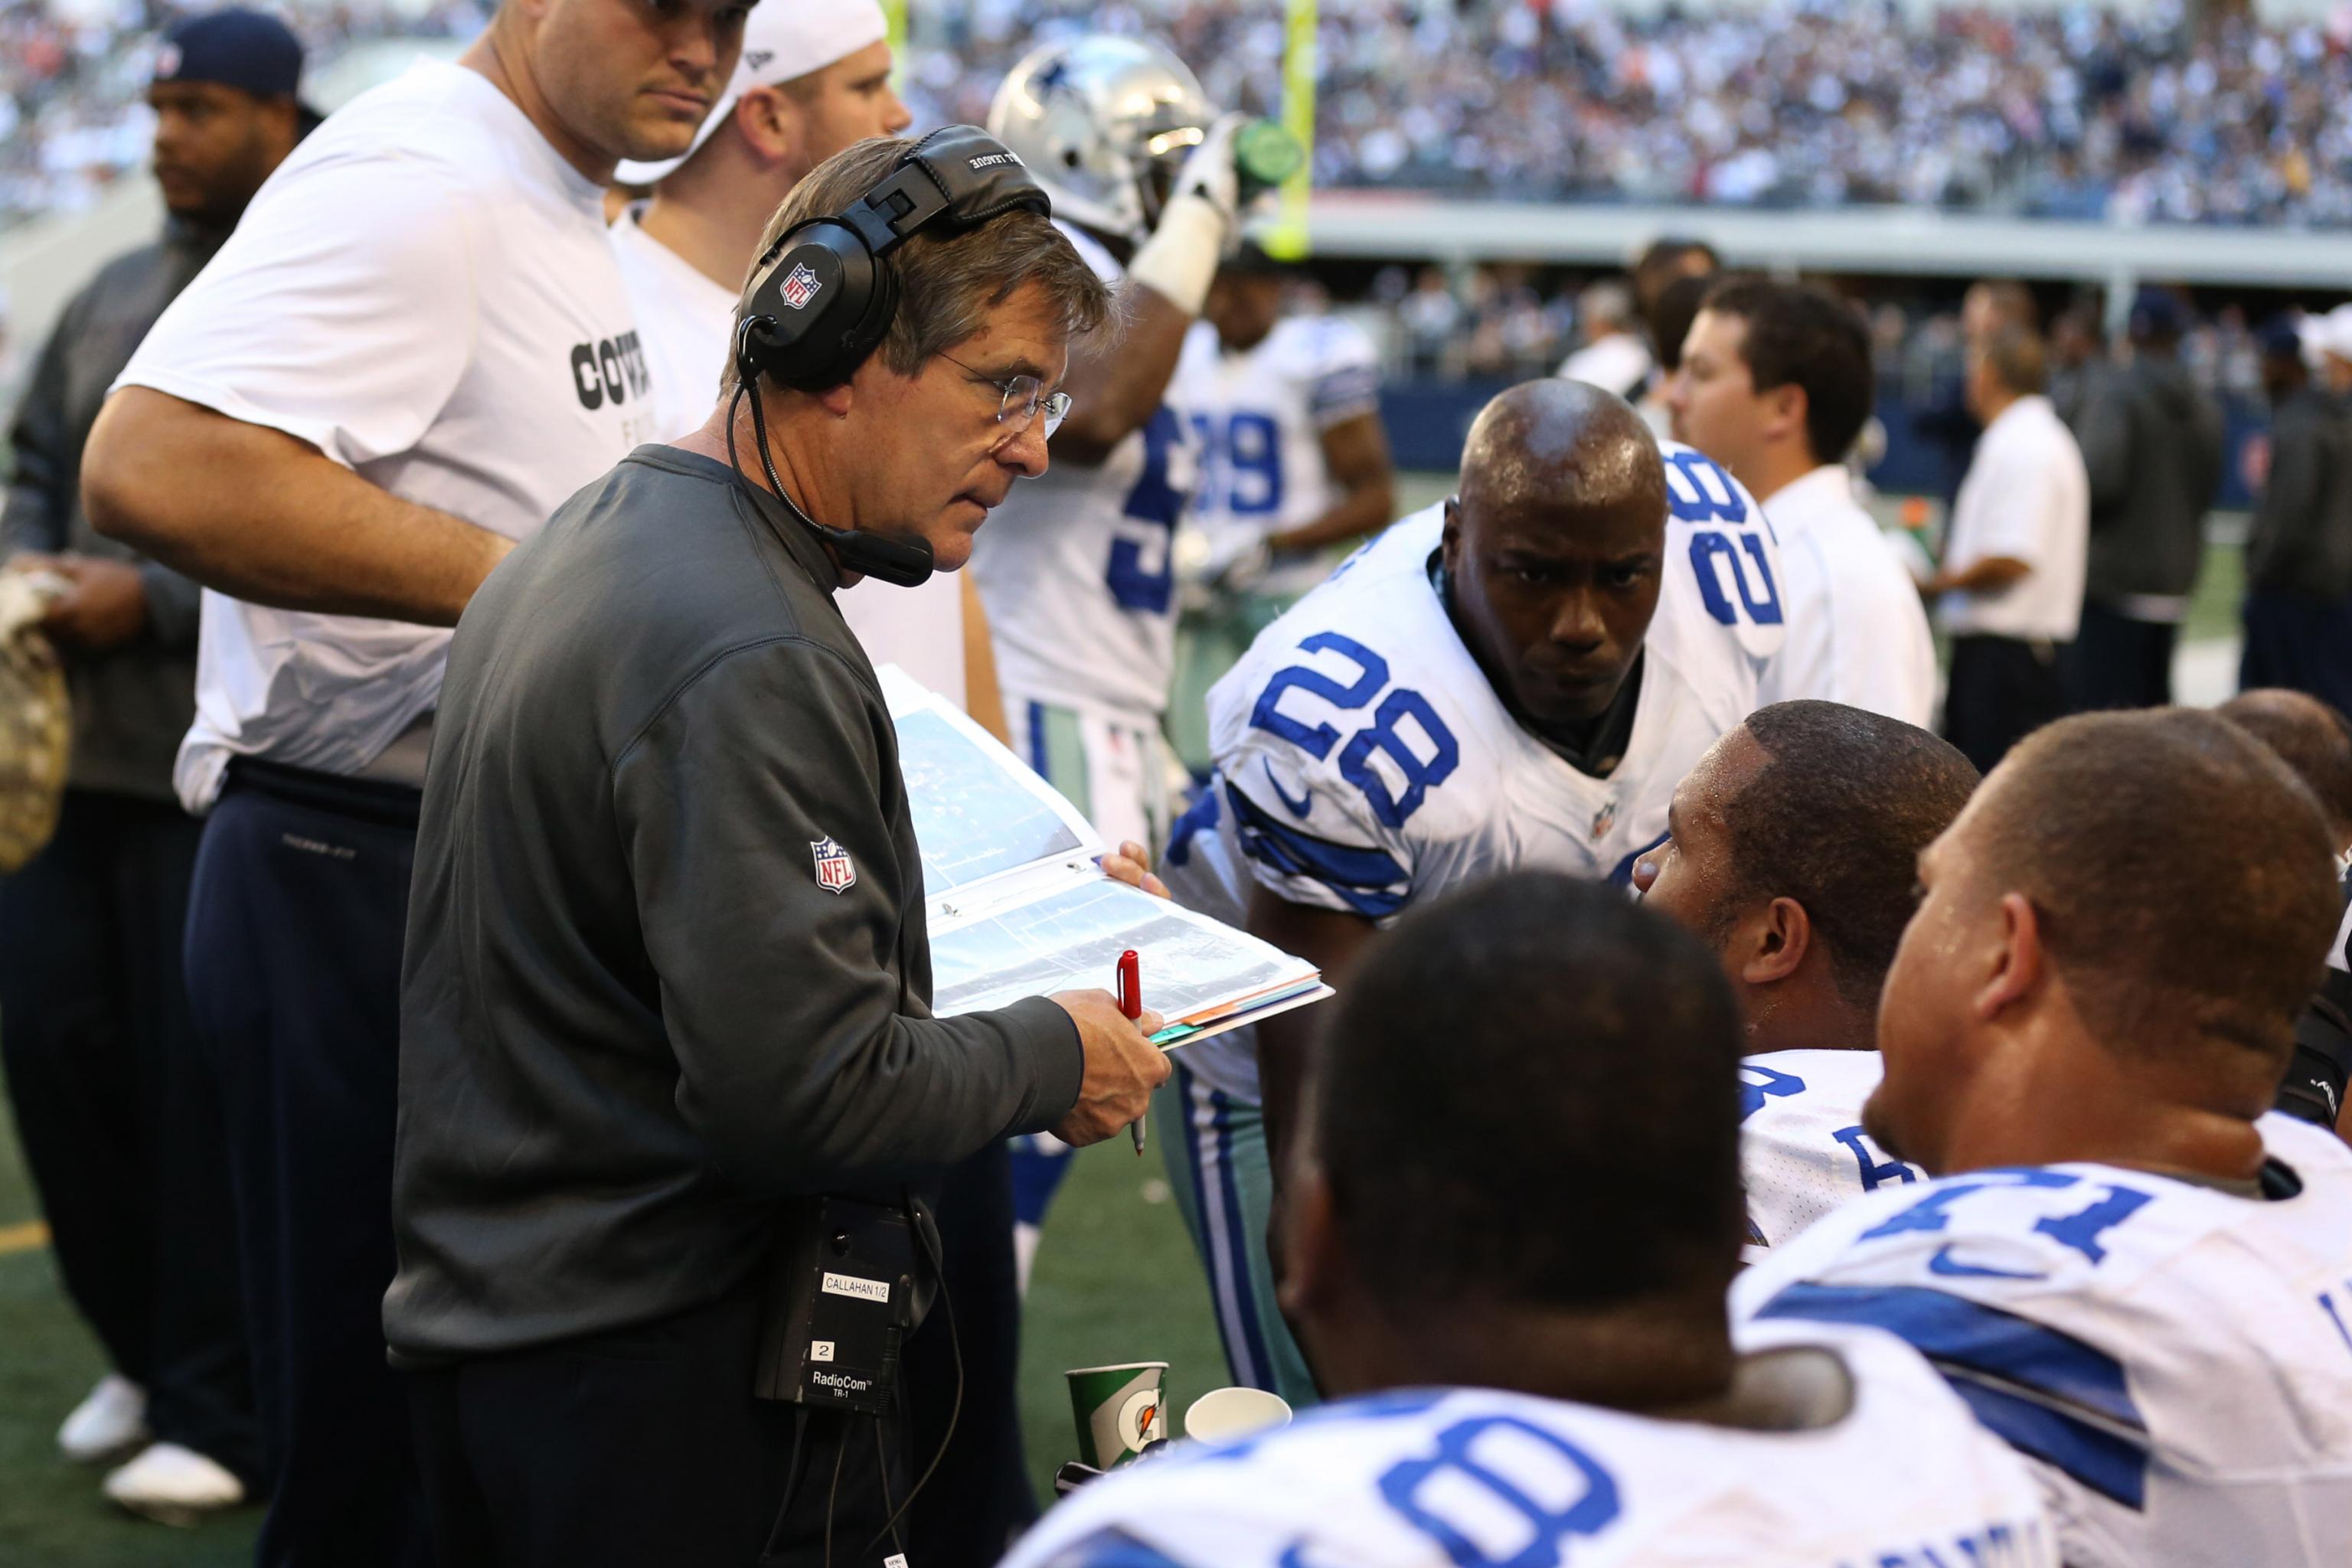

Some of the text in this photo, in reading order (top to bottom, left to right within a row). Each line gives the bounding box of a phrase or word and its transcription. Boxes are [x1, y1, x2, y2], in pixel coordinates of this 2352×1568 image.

[969, 154, 1005, 168] LEAGUE
[784, 277, 808, 305] NFL
[1663, 452, 1785, 625] 28
[1250, 631, 1459, 829] 28
[821, 859, 852, 885] NFL
[826, 1277, 887, 1298] CALLAHAN 1/2
[818, 1345, 829, 1356] 2
[833, 1388, 849, 1399] TR-1
